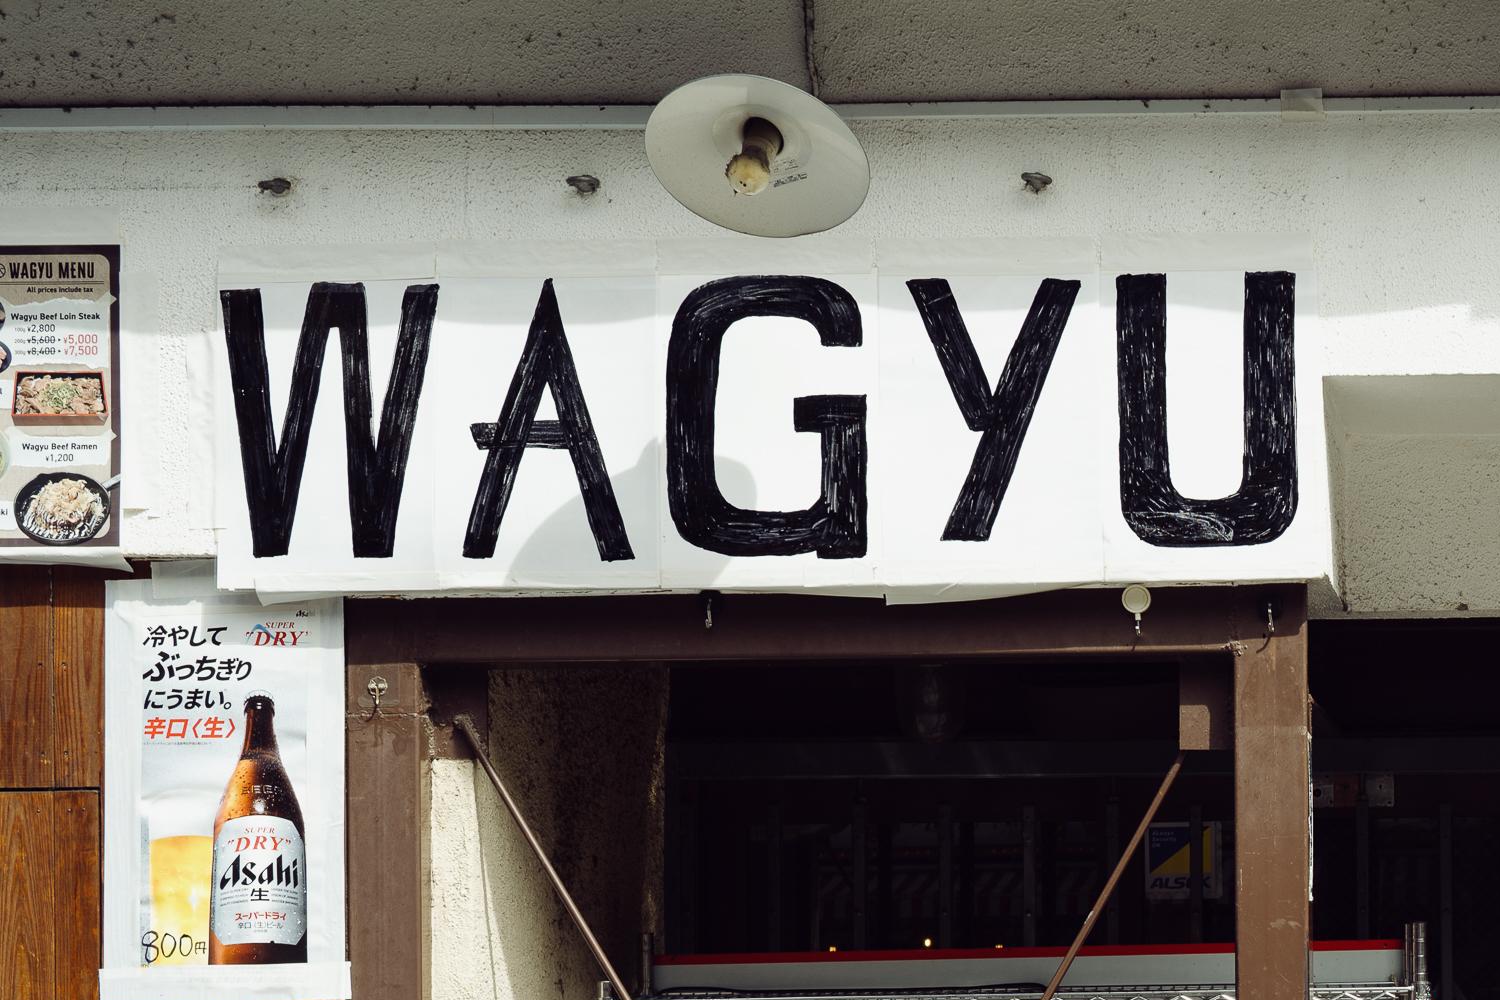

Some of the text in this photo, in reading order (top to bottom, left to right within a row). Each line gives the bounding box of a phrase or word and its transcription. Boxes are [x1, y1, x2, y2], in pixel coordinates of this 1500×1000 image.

[9, 262, 95, 279] WAGYU MENU
[37, 286, 57, 294] prices
[10, 312, 101, 321] Wagyu Beef Loin Steak
[27, 324, 56, 333] ¥2,800
[63, 334, 98, 345] ¥5,000
[63, 345, 98, 356] ¥7,500
[220, 272, 1299, 562] WAGYU
[22, 442, 98, 452] Wagyu Beef Ramen
[45, 453, 74, 463] ¥1,200
[264, 621, 295, 629] SUPER
[142, 625, 228, 648] 冷やして
[142, 650, 253, 682] ぶっちぎり
[143, 689, 233, 710] にうまい。
[243, 826, 275, 834] SUPER
[219, 854, 299, 891] Asahi
[1150, 876, 1211, 889] ALSK
[250, 888, 270, 902] 生
[234, 911, 287, 921] スーパードライ
